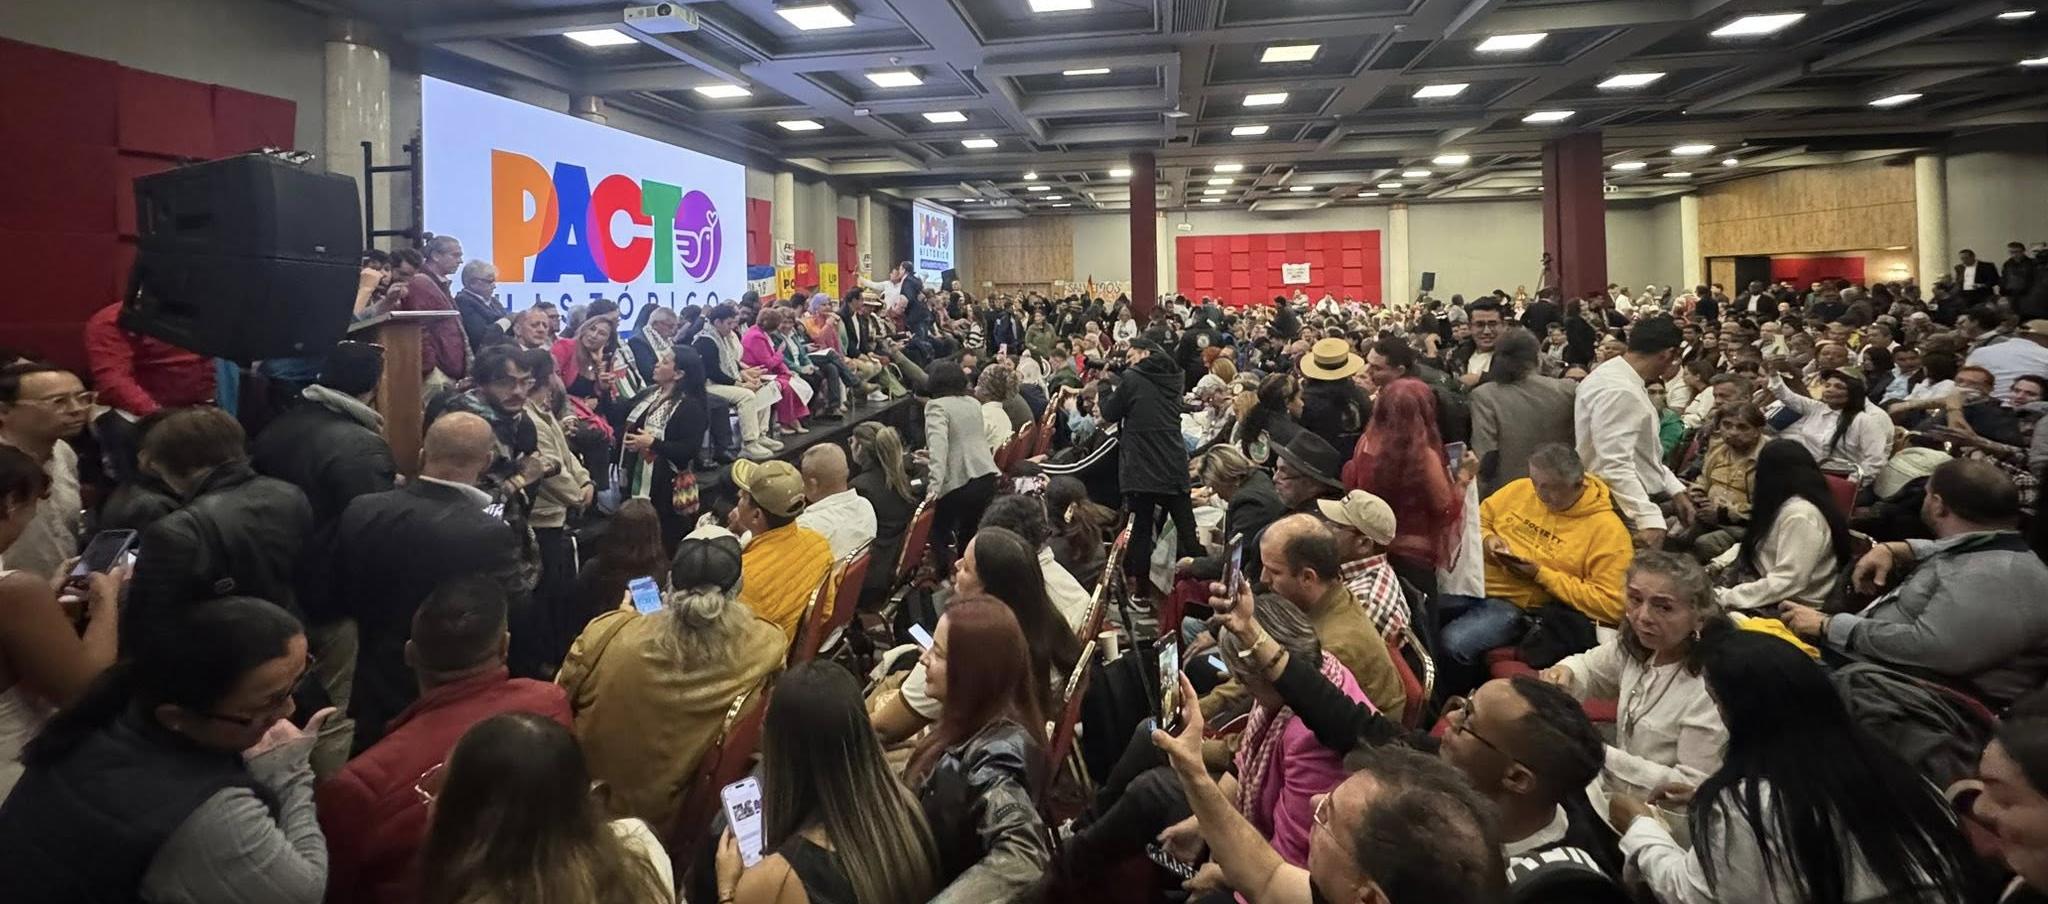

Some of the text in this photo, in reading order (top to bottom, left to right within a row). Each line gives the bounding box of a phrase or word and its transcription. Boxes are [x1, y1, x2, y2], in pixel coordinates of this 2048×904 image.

[491, 148, 723, 284] PACTO
[919, 213, 950, 250] PACTO
[1068, 281, 1121, 294] SALEMOS
